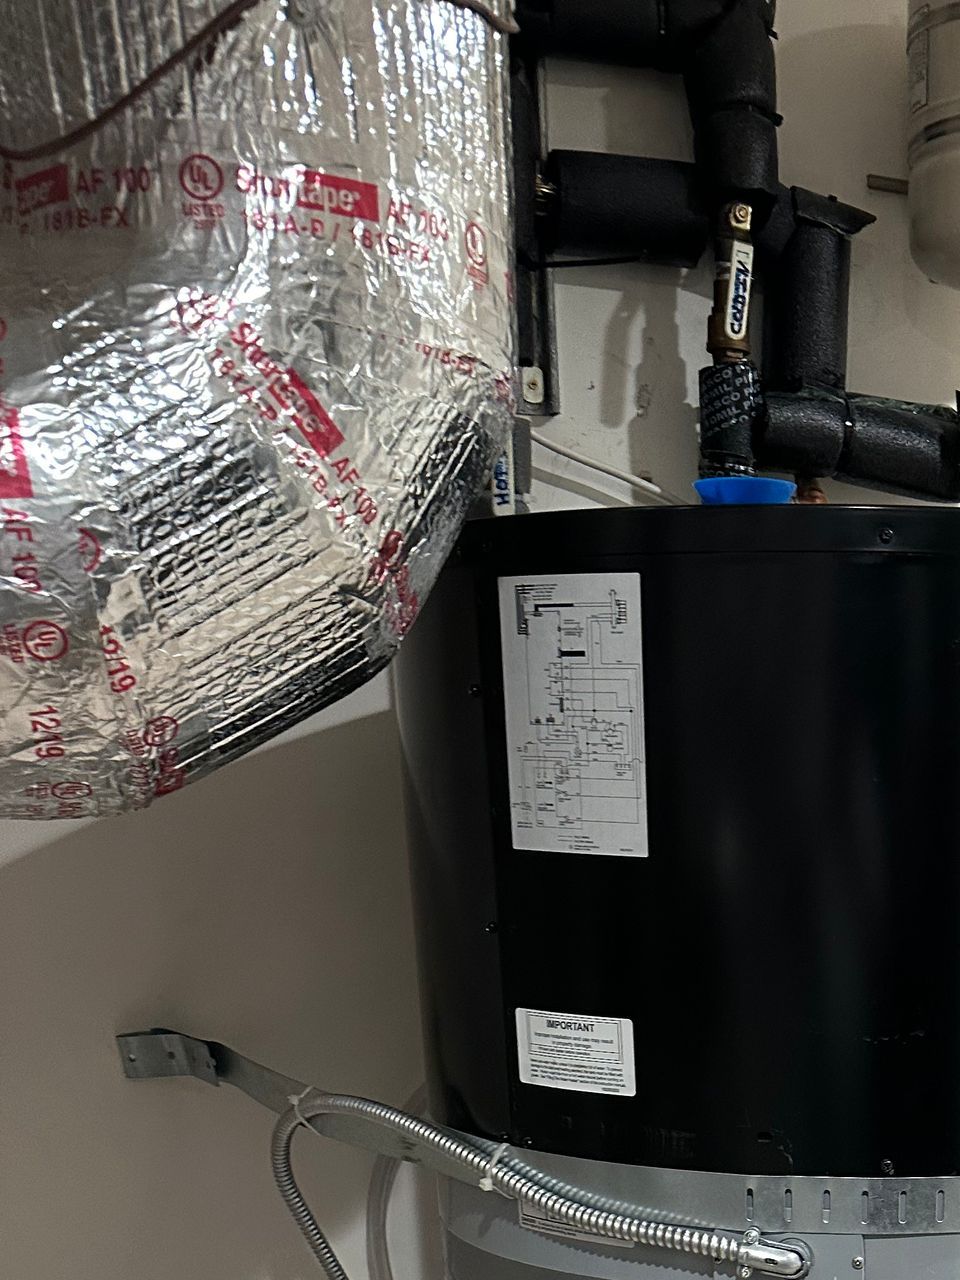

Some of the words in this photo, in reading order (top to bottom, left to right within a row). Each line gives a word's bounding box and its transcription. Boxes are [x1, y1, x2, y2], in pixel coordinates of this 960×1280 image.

[112, 166, 150, 193] 100
[331, 456, 362, 485] AF
[546, 1019, 595, 1033] IMPORTANT
